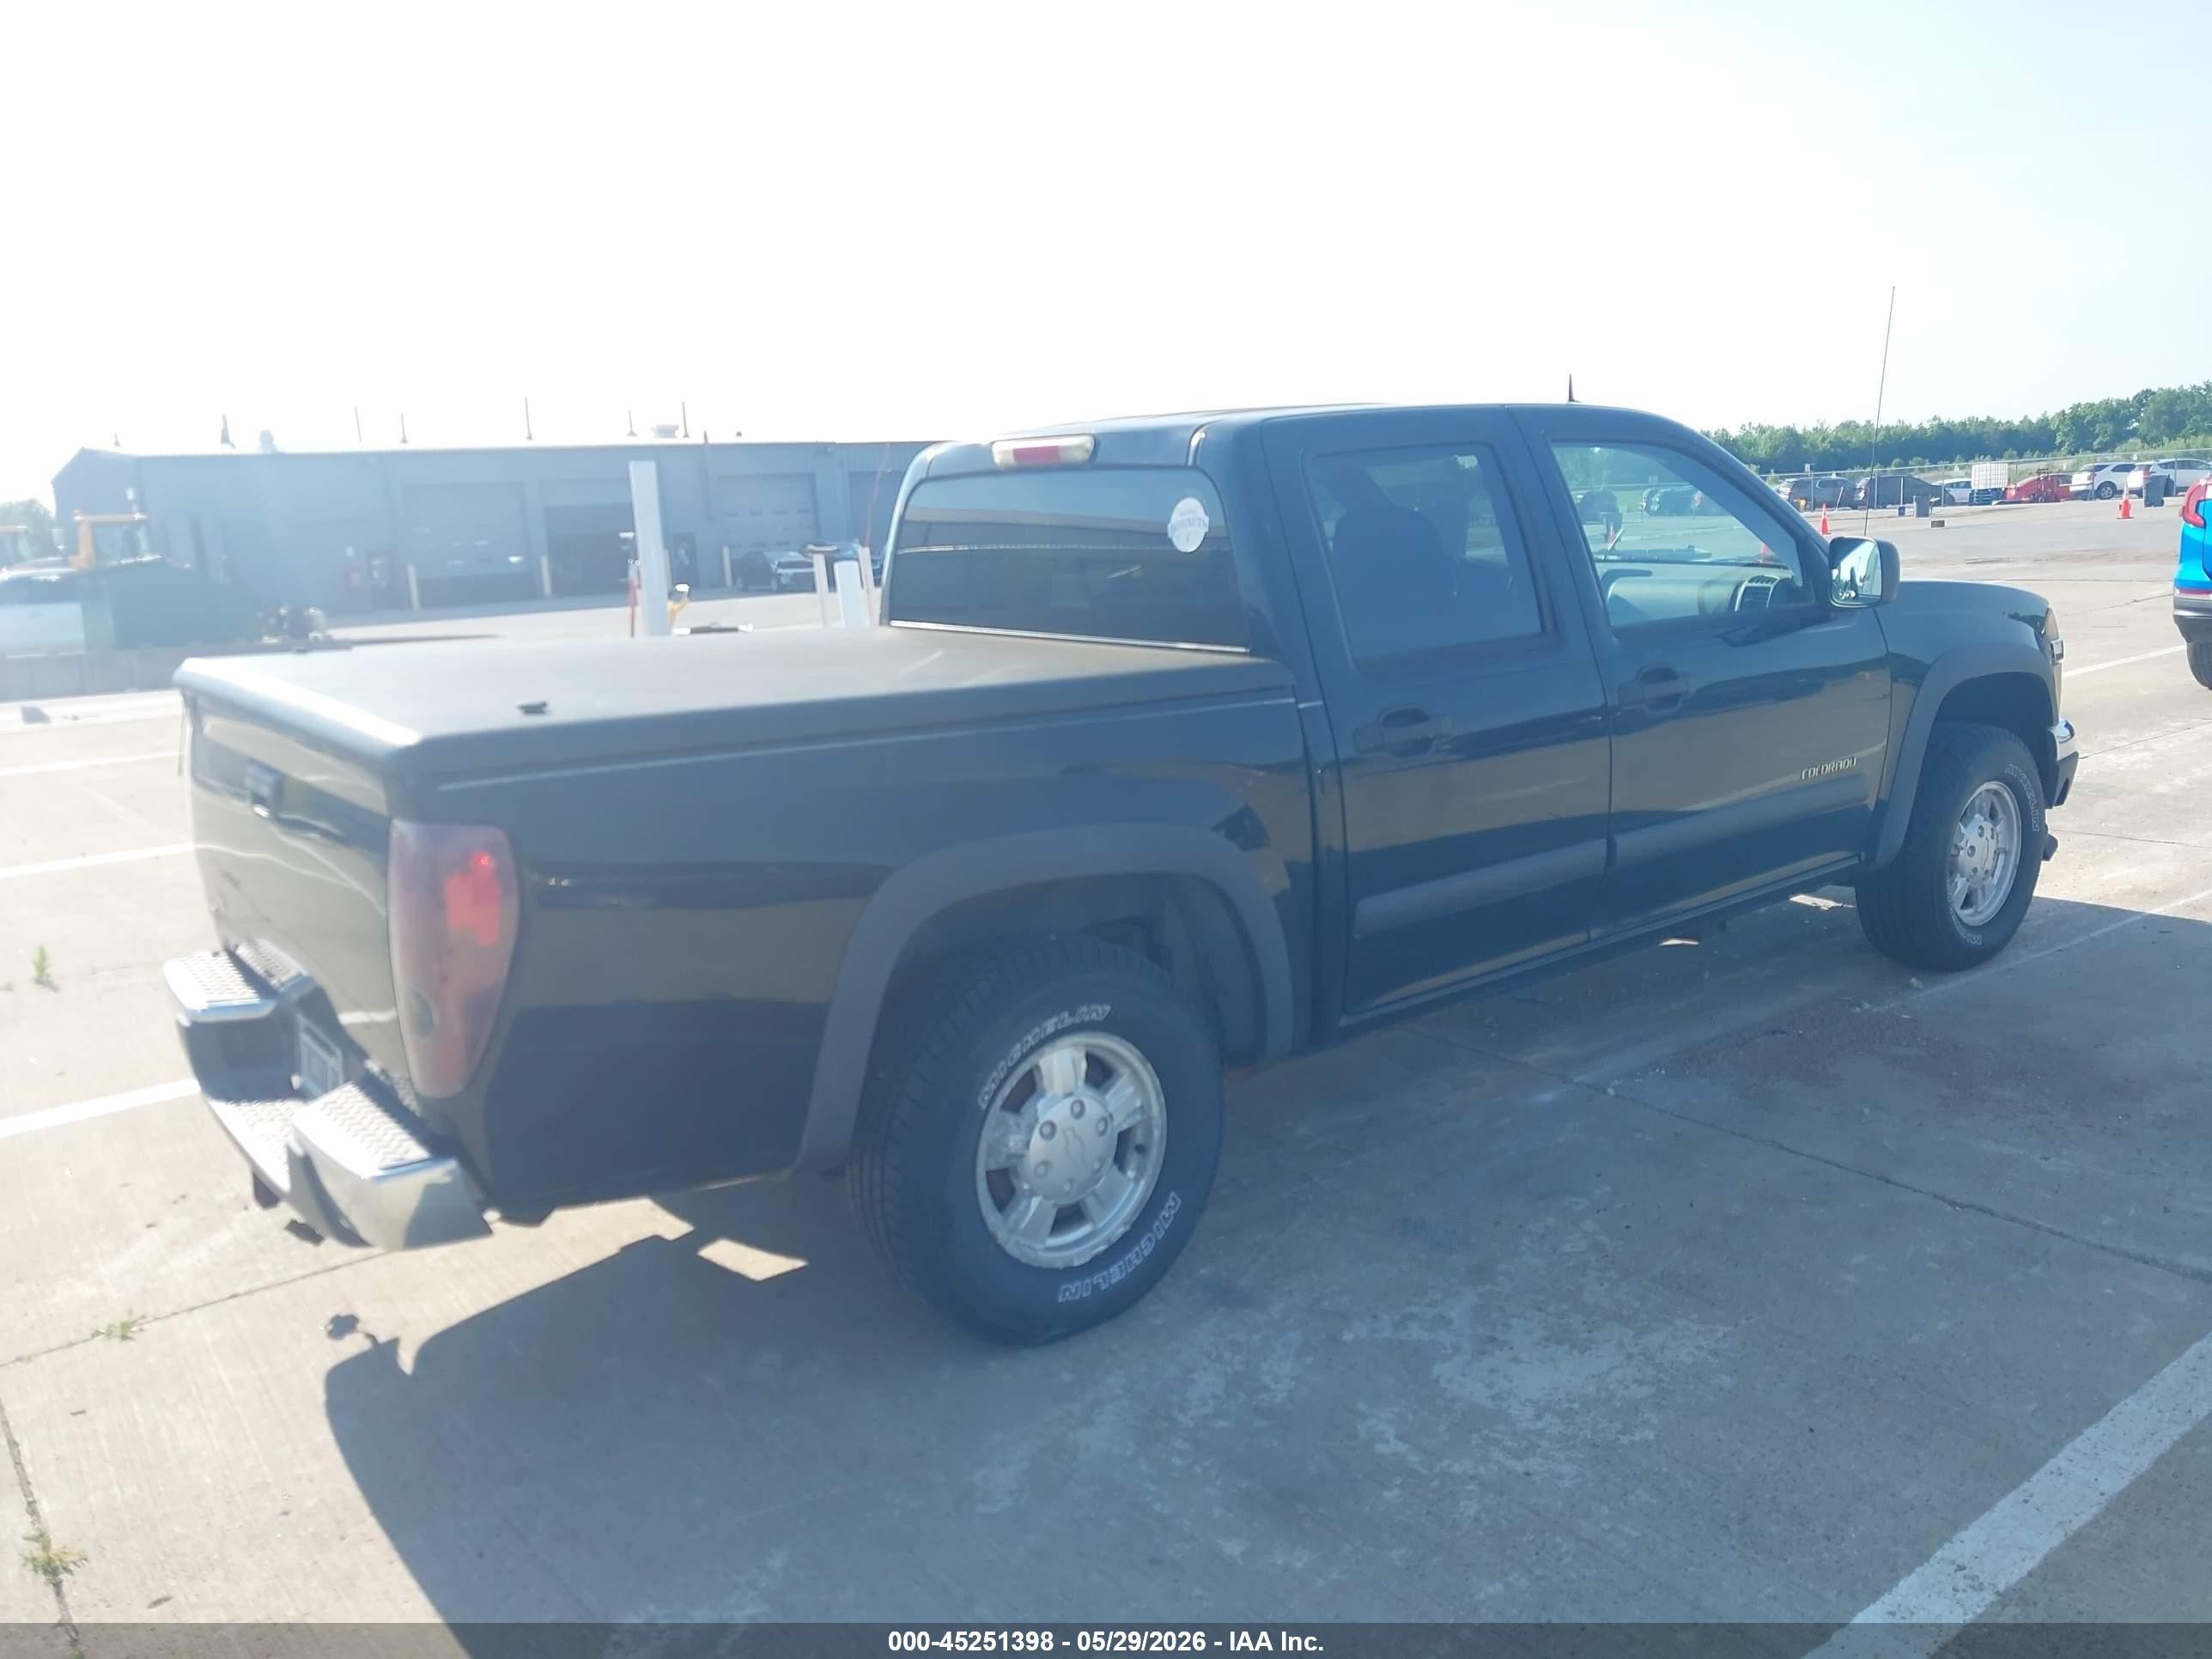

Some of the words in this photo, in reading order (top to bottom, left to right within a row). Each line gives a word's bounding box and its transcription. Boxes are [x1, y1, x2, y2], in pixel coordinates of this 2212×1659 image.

[1801, 757, 1857, 780] COLORADO
[977, 1004, 1112, 1110] MICHELIN
[1057, 1192, 1182, 1303] MICHELIN
